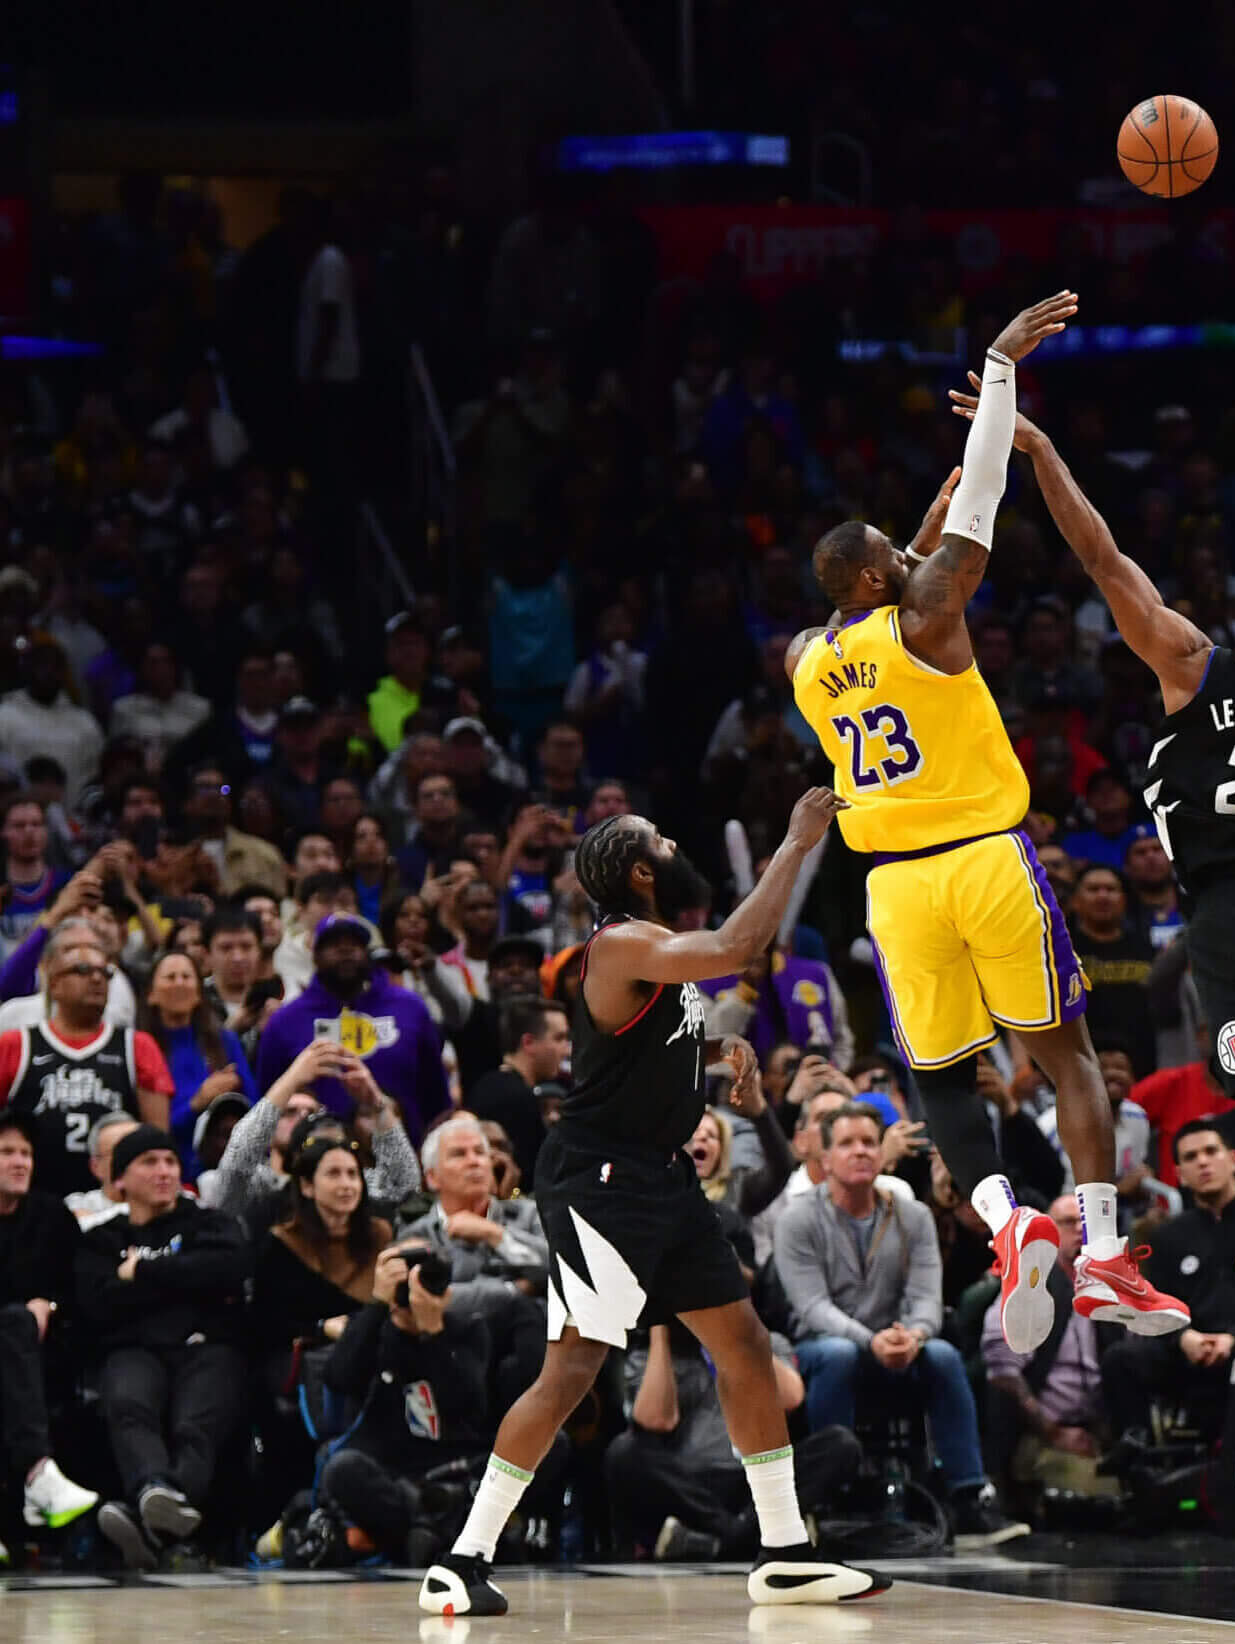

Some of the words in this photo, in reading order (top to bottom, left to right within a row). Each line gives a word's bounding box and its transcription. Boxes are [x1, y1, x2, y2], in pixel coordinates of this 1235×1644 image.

[819, 662, 878, 699] JAMES
[830, 702, 926, 794] 23
[65, 1112, 90, 1153] 2
